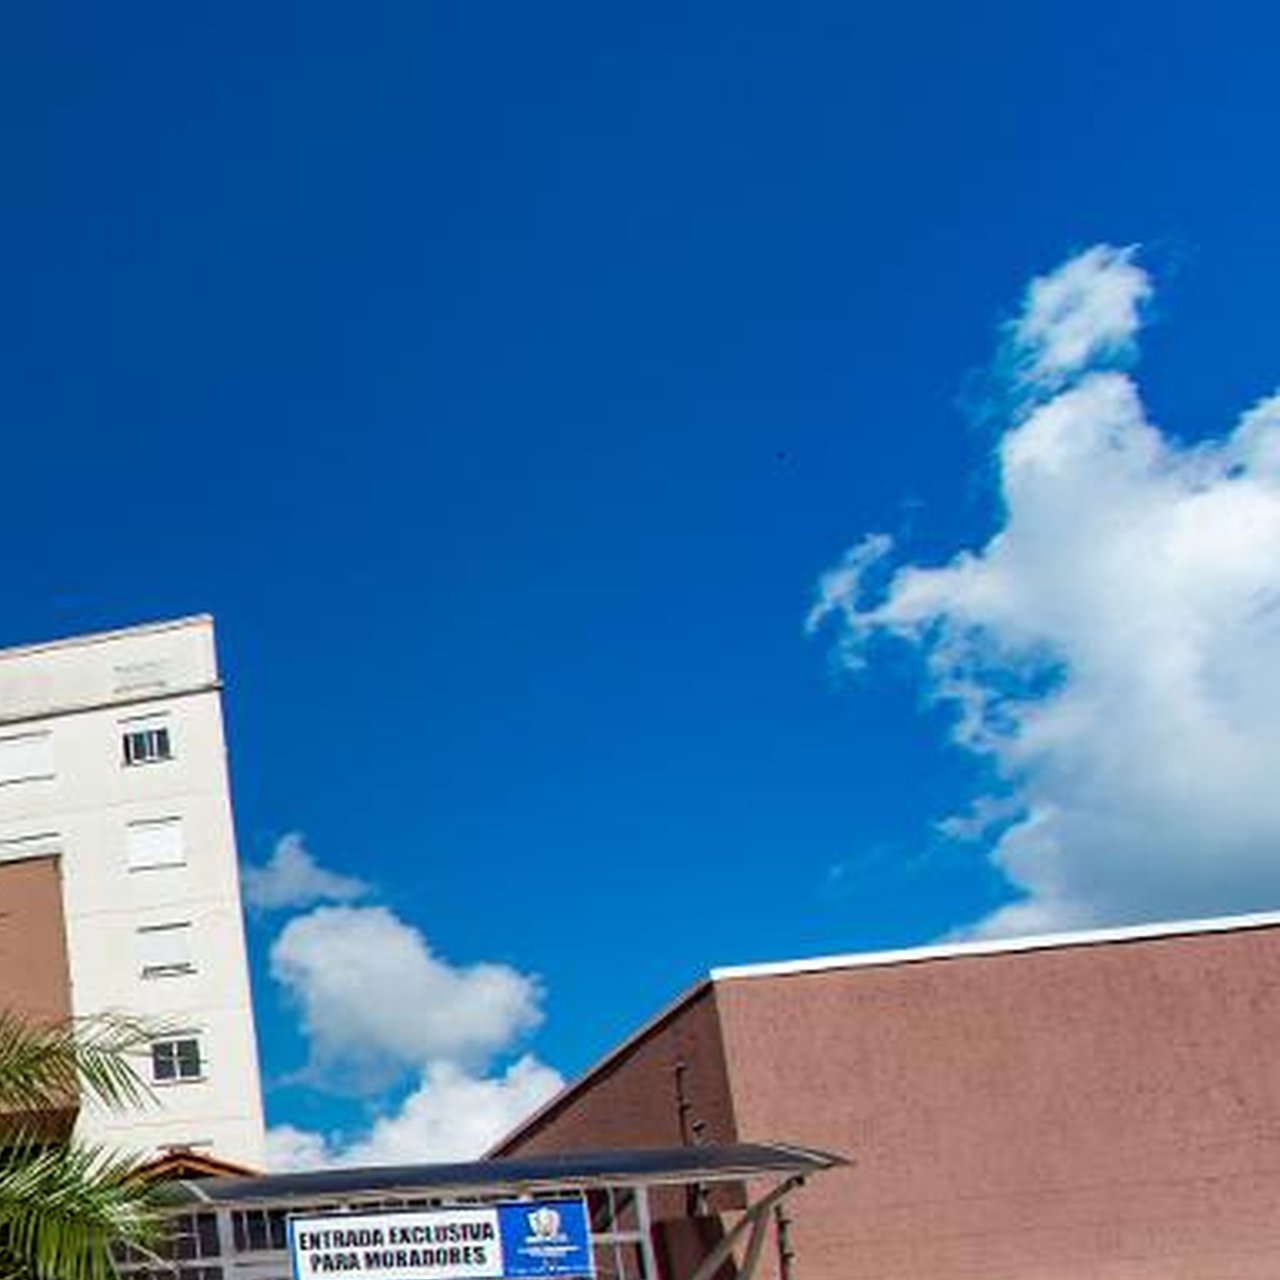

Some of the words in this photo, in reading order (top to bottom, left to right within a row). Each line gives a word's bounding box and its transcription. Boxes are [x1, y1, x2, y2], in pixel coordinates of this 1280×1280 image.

[298, 1226, 385, 1252] ENTRADA
[389, 1221, 496, 1246] EXCLUSIVA
[310, 1252, 362, 1274] PARA
[363, 1245, 488, 1271] MORADORES
